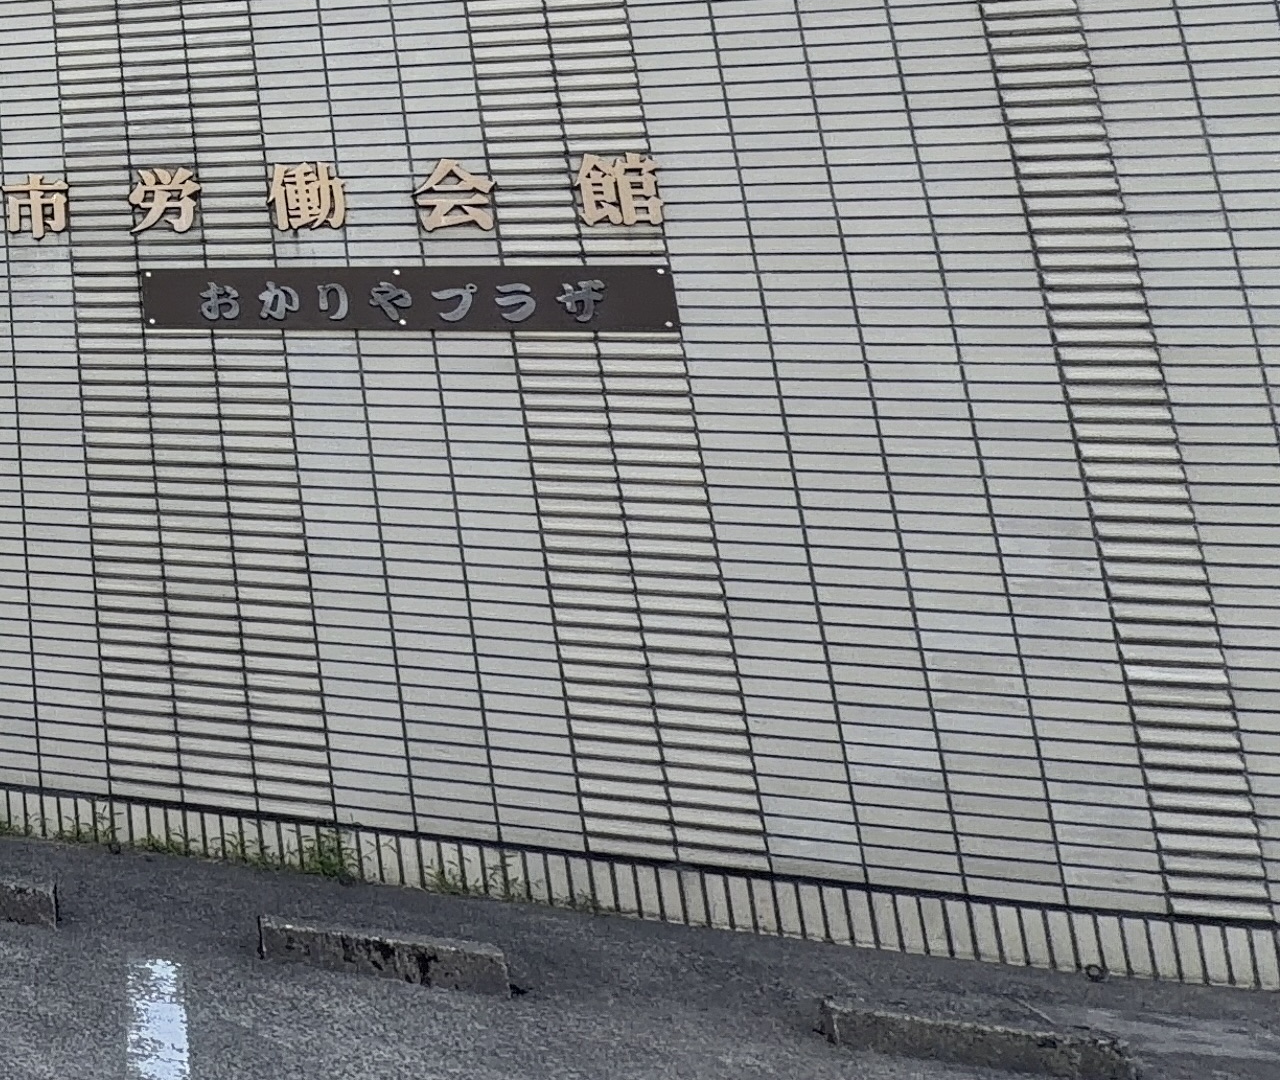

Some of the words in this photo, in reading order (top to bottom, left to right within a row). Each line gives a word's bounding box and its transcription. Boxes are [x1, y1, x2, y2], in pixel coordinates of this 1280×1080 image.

[199, 280, 606, 323] おかりやプラザ
